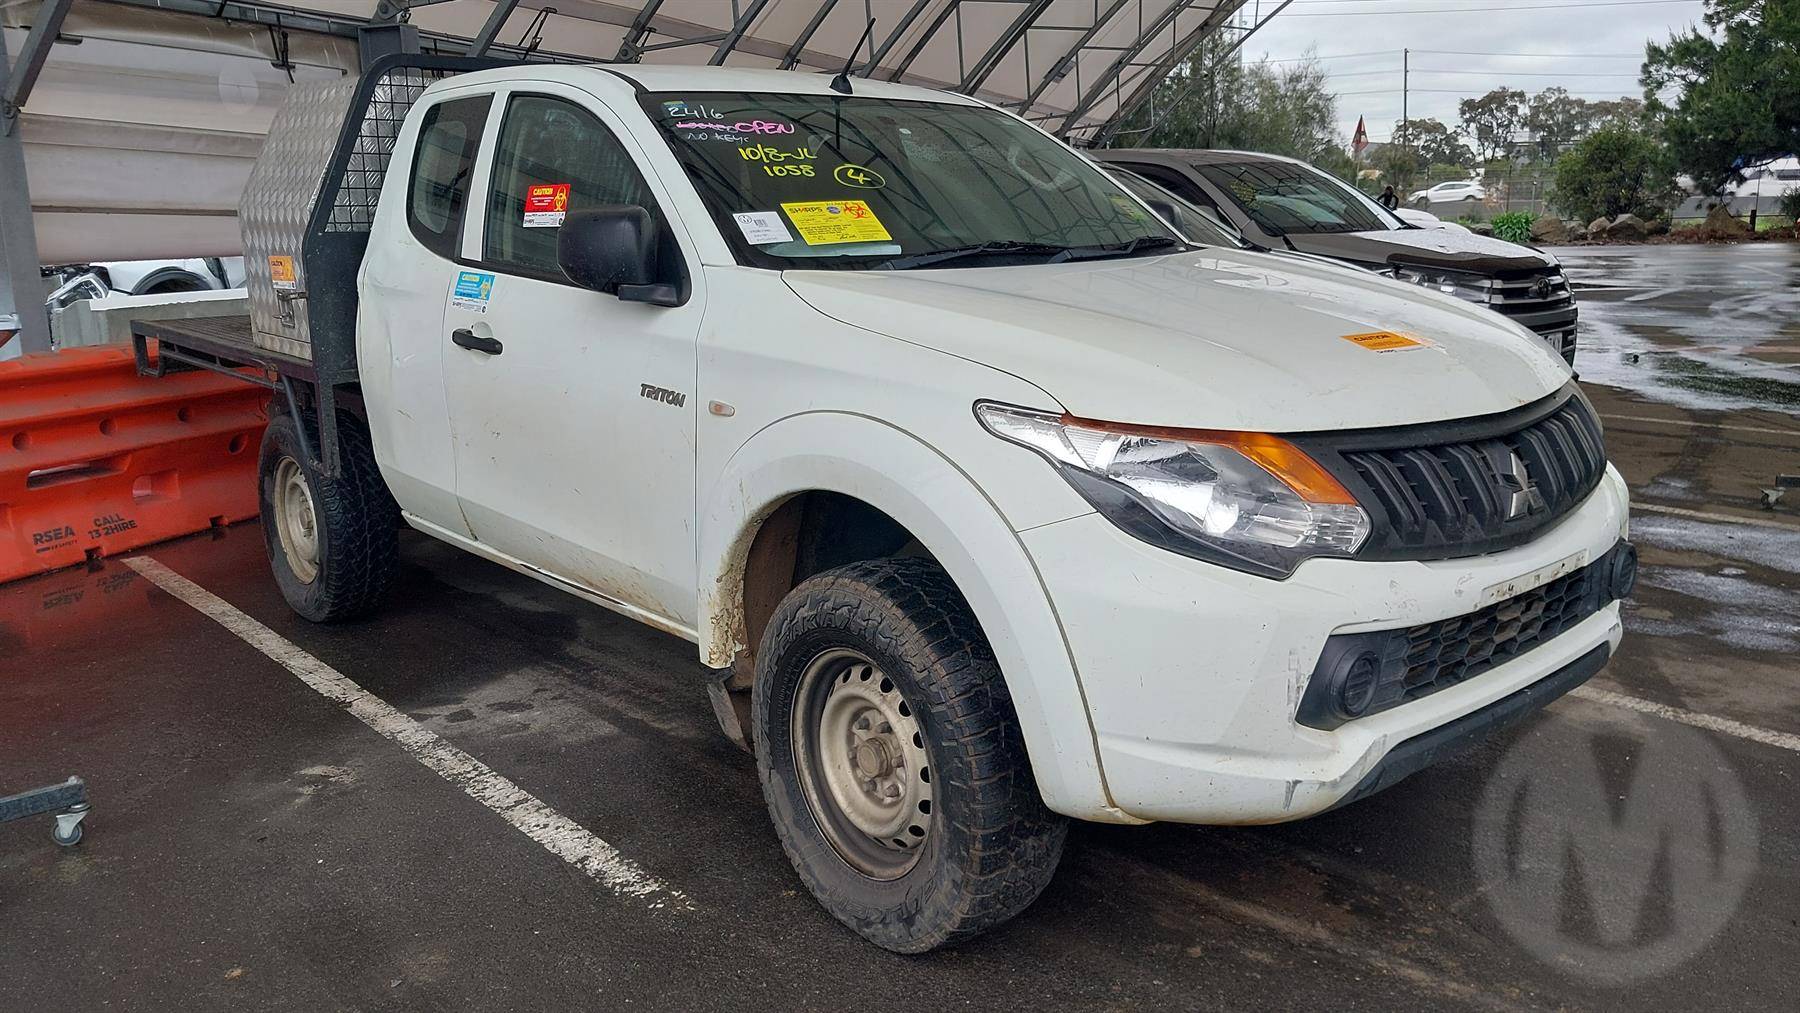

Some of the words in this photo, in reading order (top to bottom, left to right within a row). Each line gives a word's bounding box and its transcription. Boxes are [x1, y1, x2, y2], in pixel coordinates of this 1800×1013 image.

[735, 120, 795, 135] OPEN
[763, 164, 816, 178] 1058
[846, 167, 873, 185] 4
[640, 383, 687, 408] TRITON
[88, 529, 102, 540] 13
[103, 519, 138, 536] 2HIRE
[94, 513, 125, 528] CALL
[32, 526, 75, 545] RSEA
